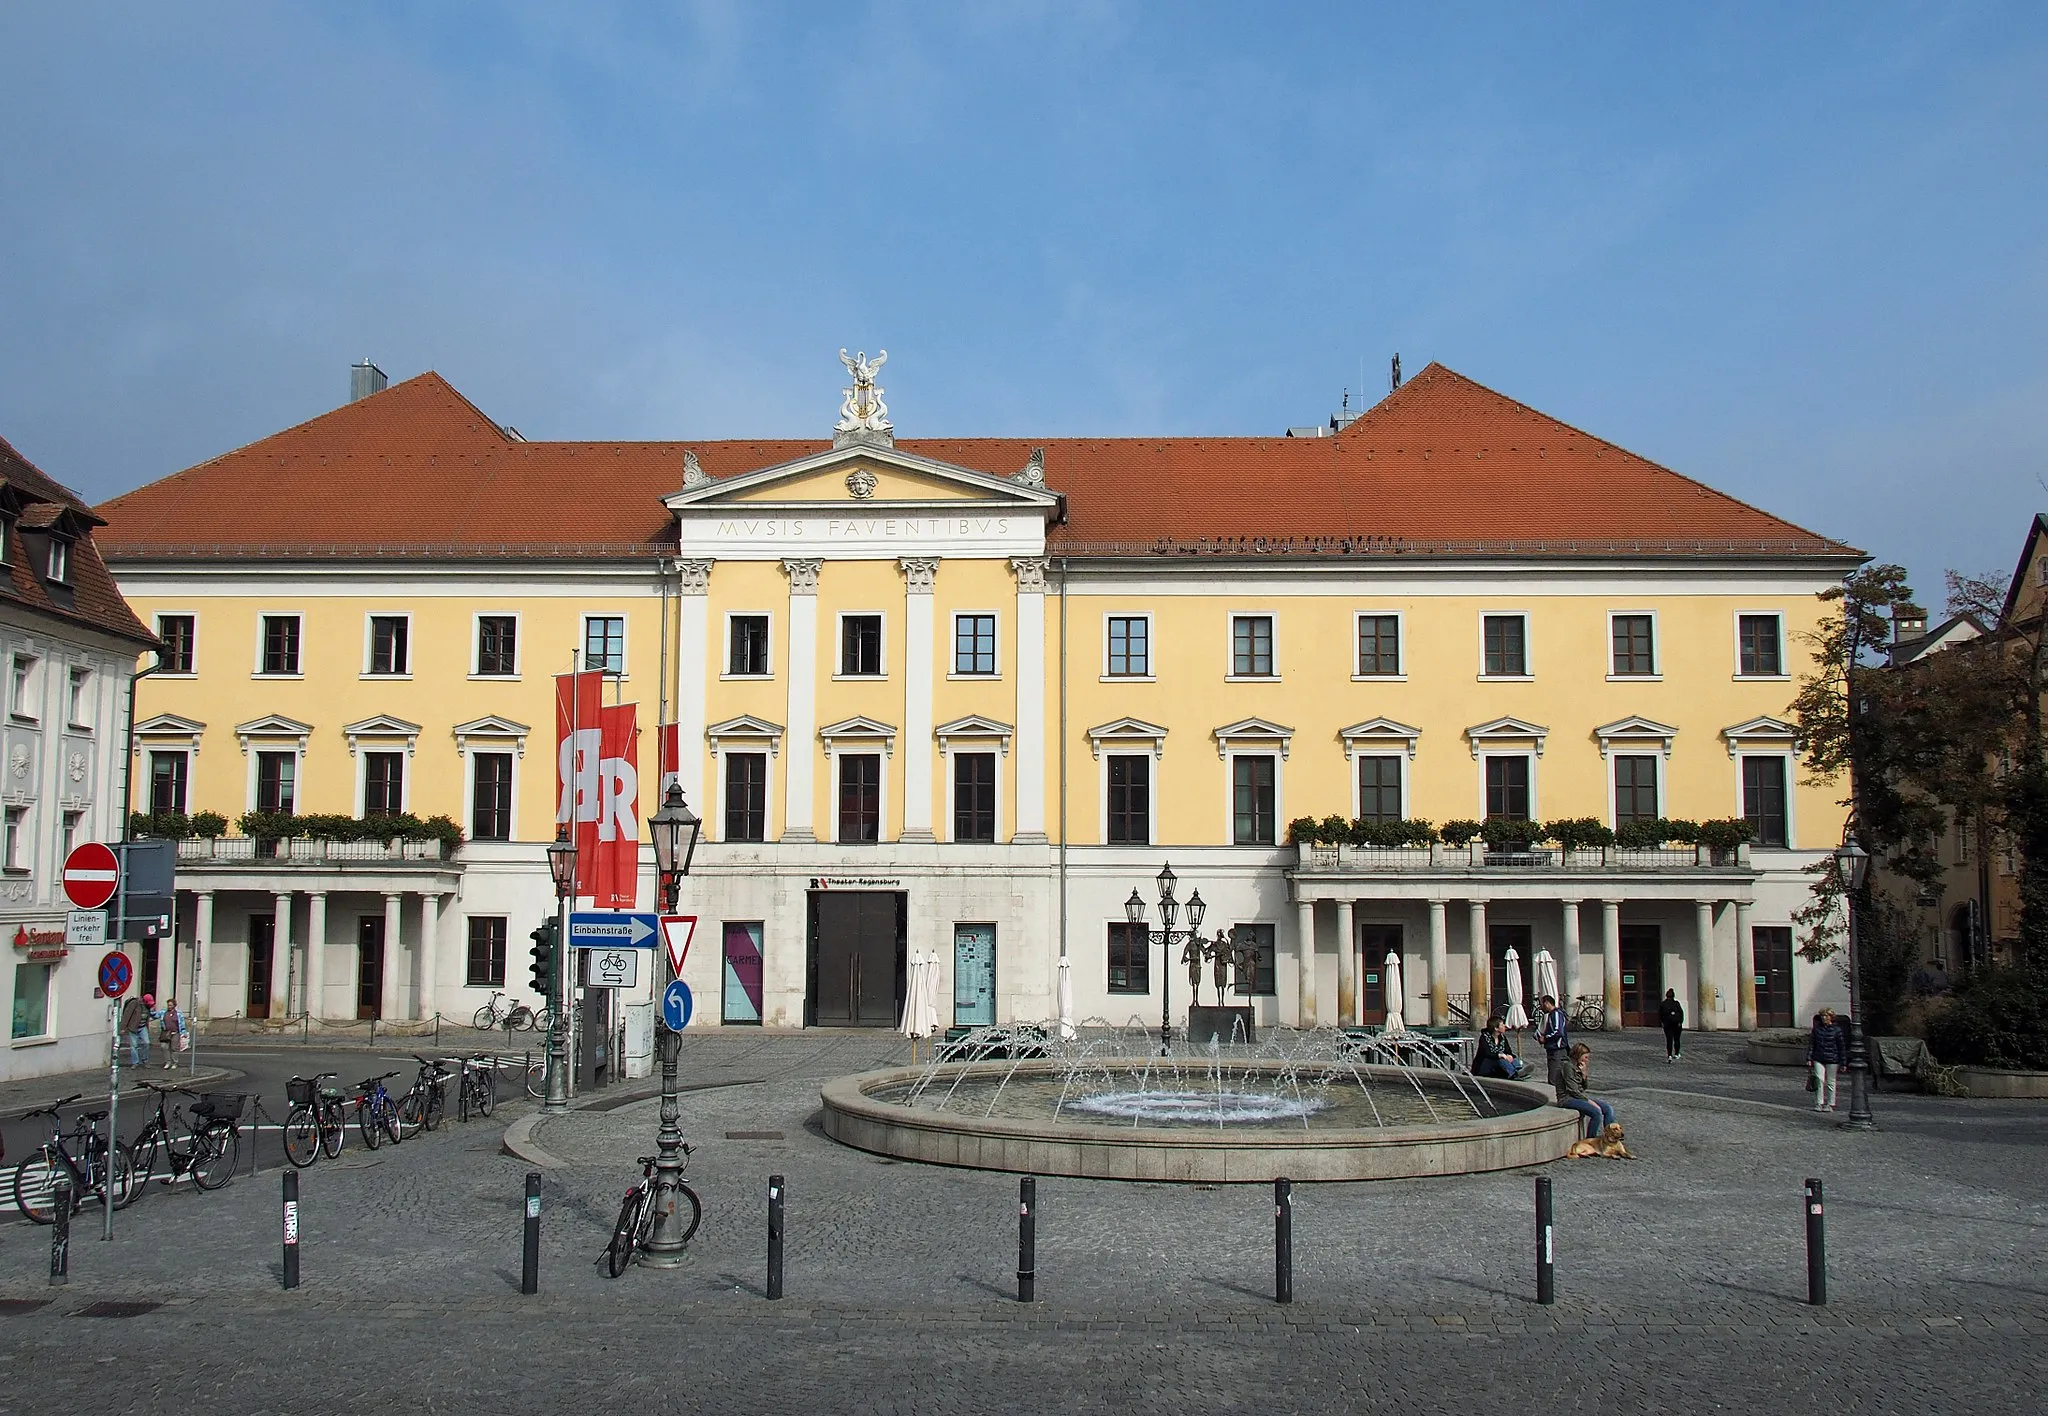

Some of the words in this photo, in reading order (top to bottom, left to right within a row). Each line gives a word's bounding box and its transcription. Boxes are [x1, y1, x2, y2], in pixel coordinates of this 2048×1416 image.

[717, 520, 803, 536] MVSIS
[828, 518, 1008, 536] FAVENTIBVS
[599, 756, 639, 842] R
[858, 878, 900, 887] Regensburg
[73, 914, 100, 923] Linien-
[71, 924, 101, 932] verkehr
[574, 925, 633, 935] Einbahnstraße
[79, 934, 93, 942] frei
